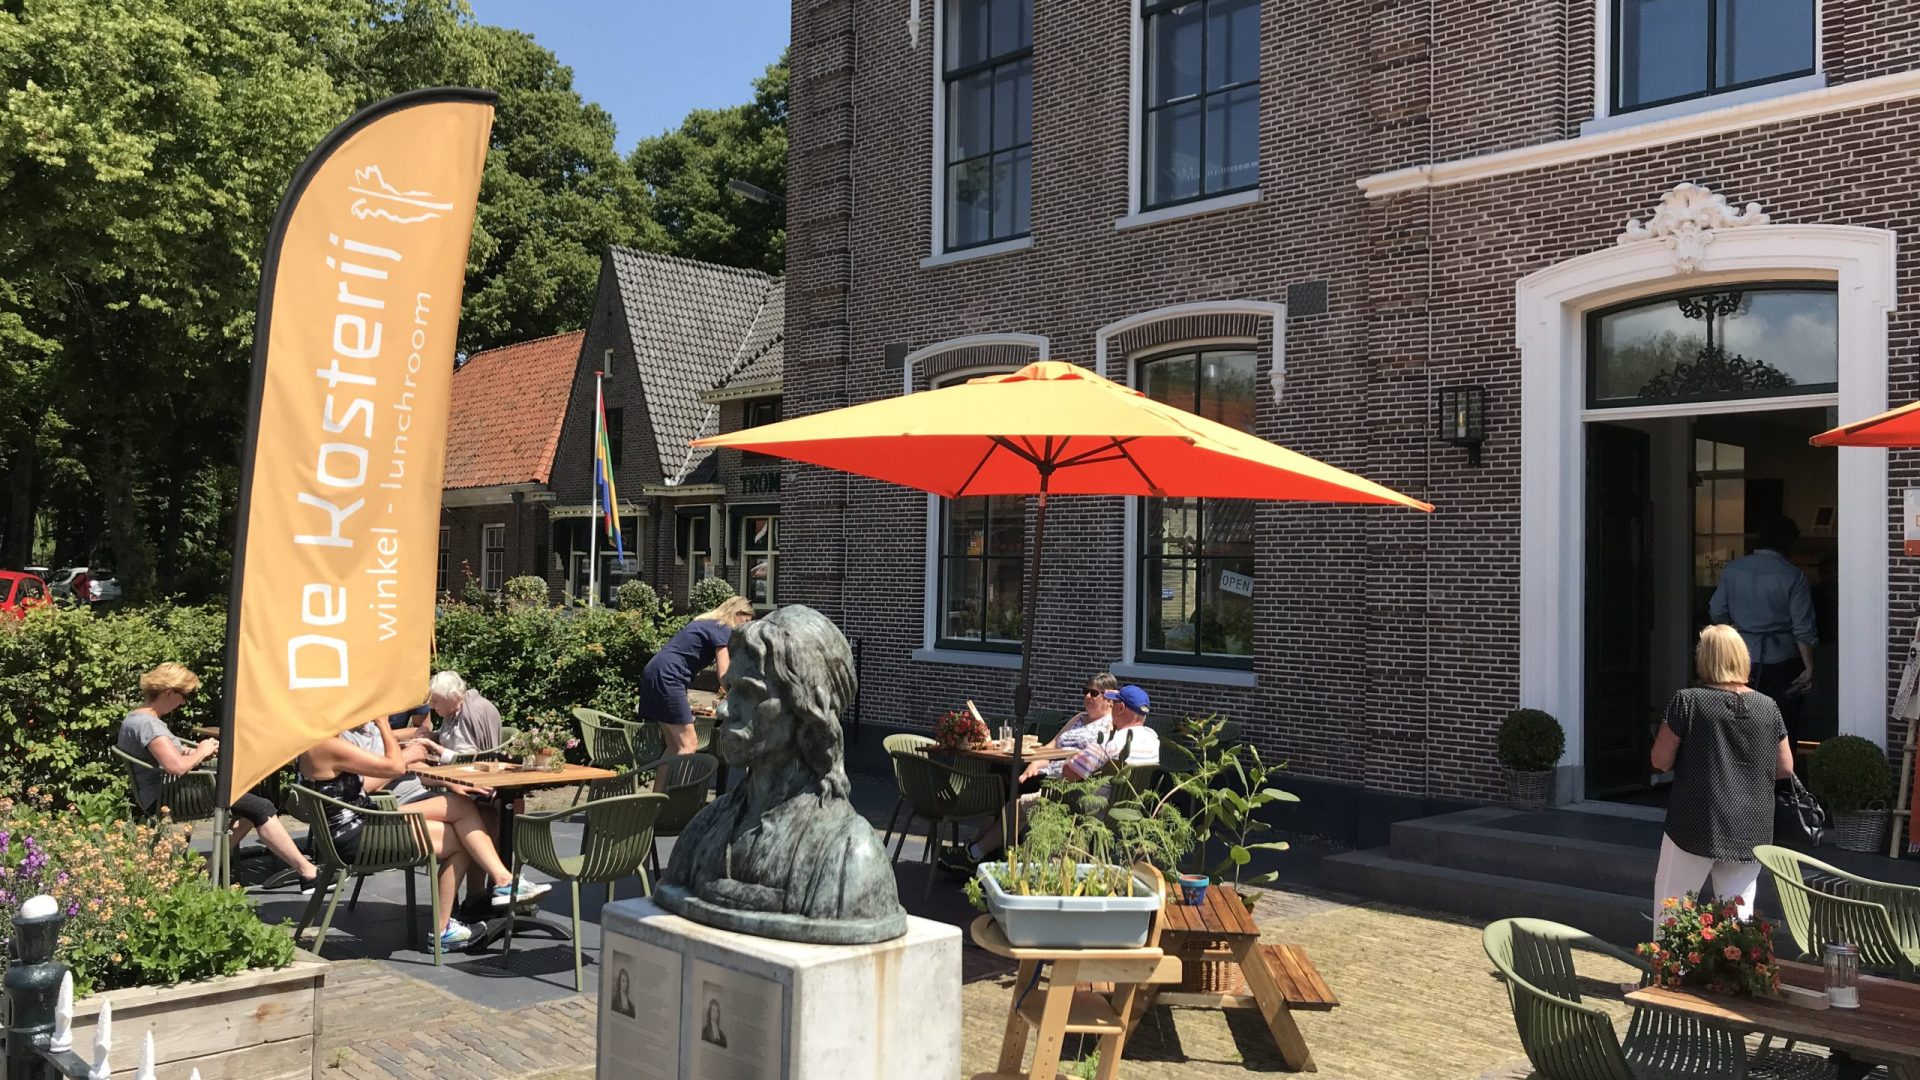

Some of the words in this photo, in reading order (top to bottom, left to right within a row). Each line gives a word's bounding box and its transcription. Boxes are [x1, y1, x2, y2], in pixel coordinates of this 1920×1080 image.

[293, 233, 402, 548] Kosterij
[380, 291, 431, 490] lunchroom
[287, 583, 350, 690] De
[365, 527, 399, 642] winkel
[1222, 575, 1250, 592] OPEN
